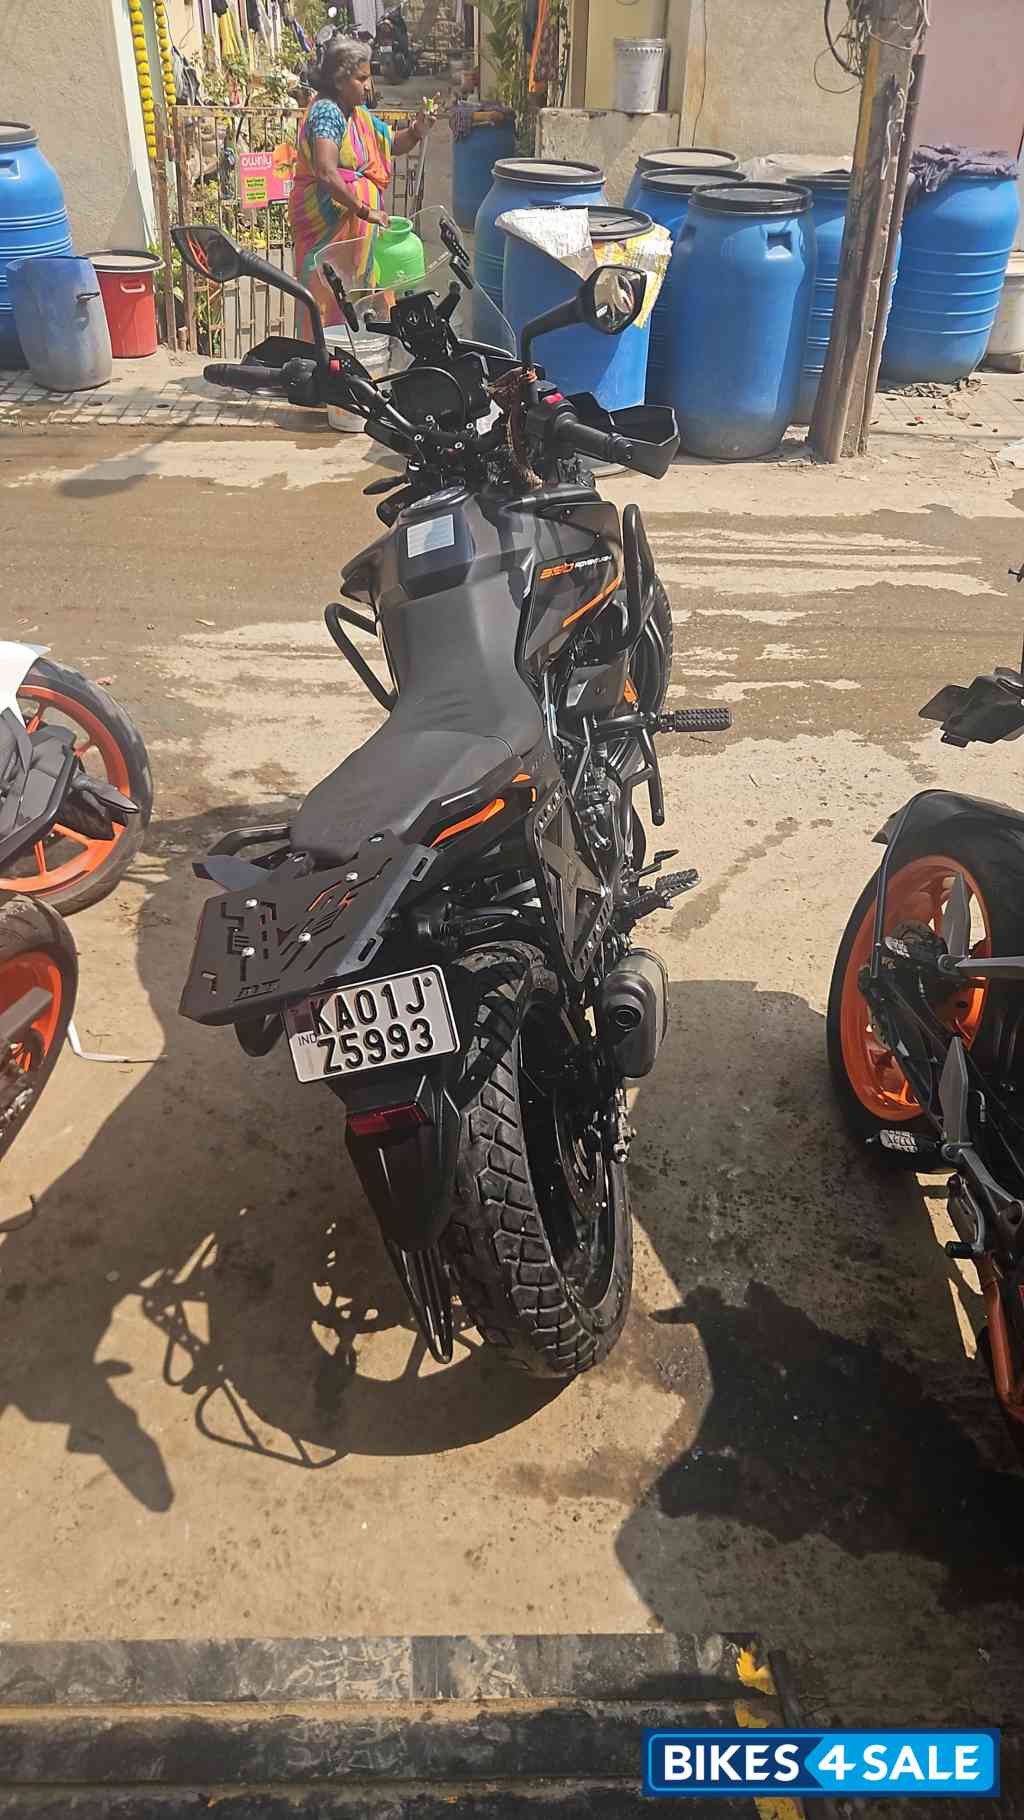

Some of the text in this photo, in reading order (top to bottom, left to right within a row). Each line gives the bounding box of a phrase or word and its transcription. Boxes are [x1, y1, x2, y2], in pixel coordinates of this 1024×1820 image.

[310, 976, 425, 1036] KA01J
[297, 1033, 318, 1047] IND
[316, 1017, 434, 1075] Z5993
